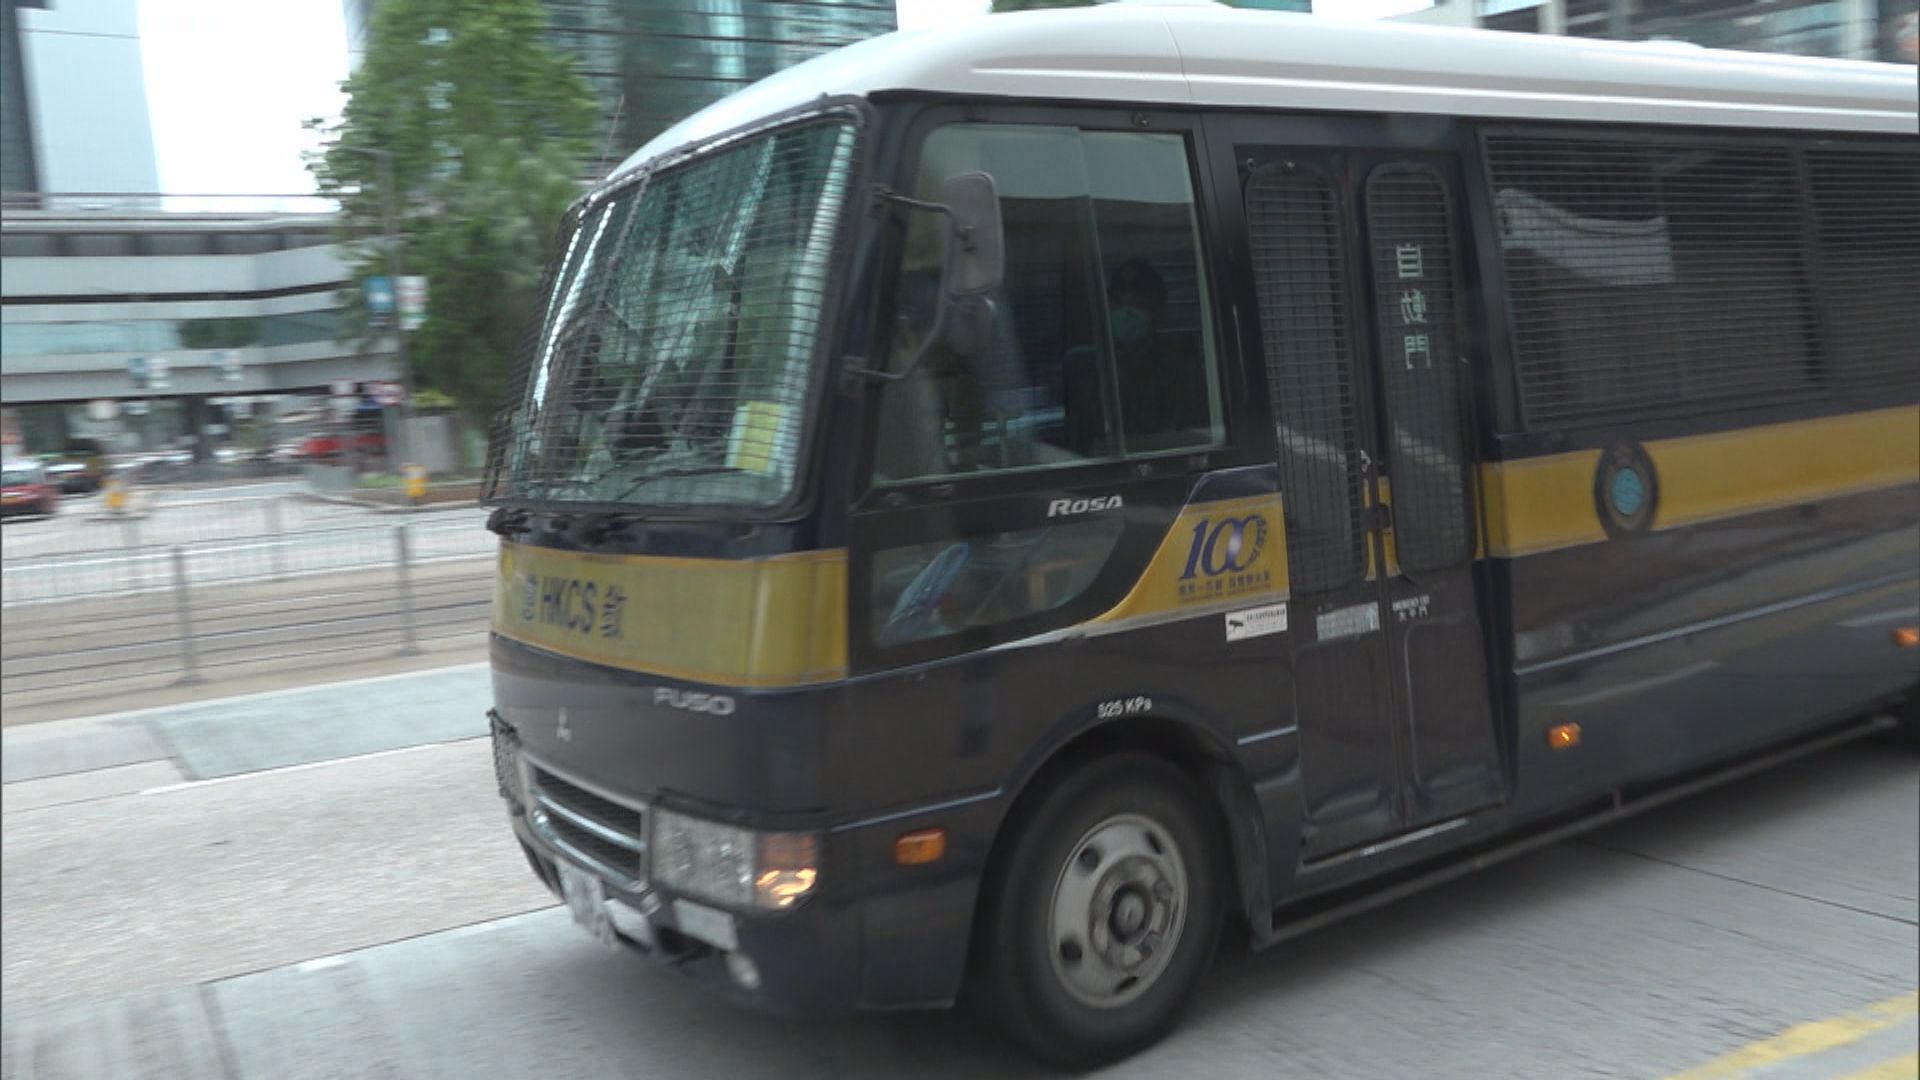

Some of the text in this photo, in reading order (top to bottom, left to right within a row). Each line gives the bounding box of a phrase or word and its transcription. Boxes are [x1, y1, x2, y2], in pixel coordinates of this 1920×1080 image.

[1178, 514, 1267, 579] 100
[540, 576, 597, 634] HKCS
[653, 687, 736, 716] FUSO
